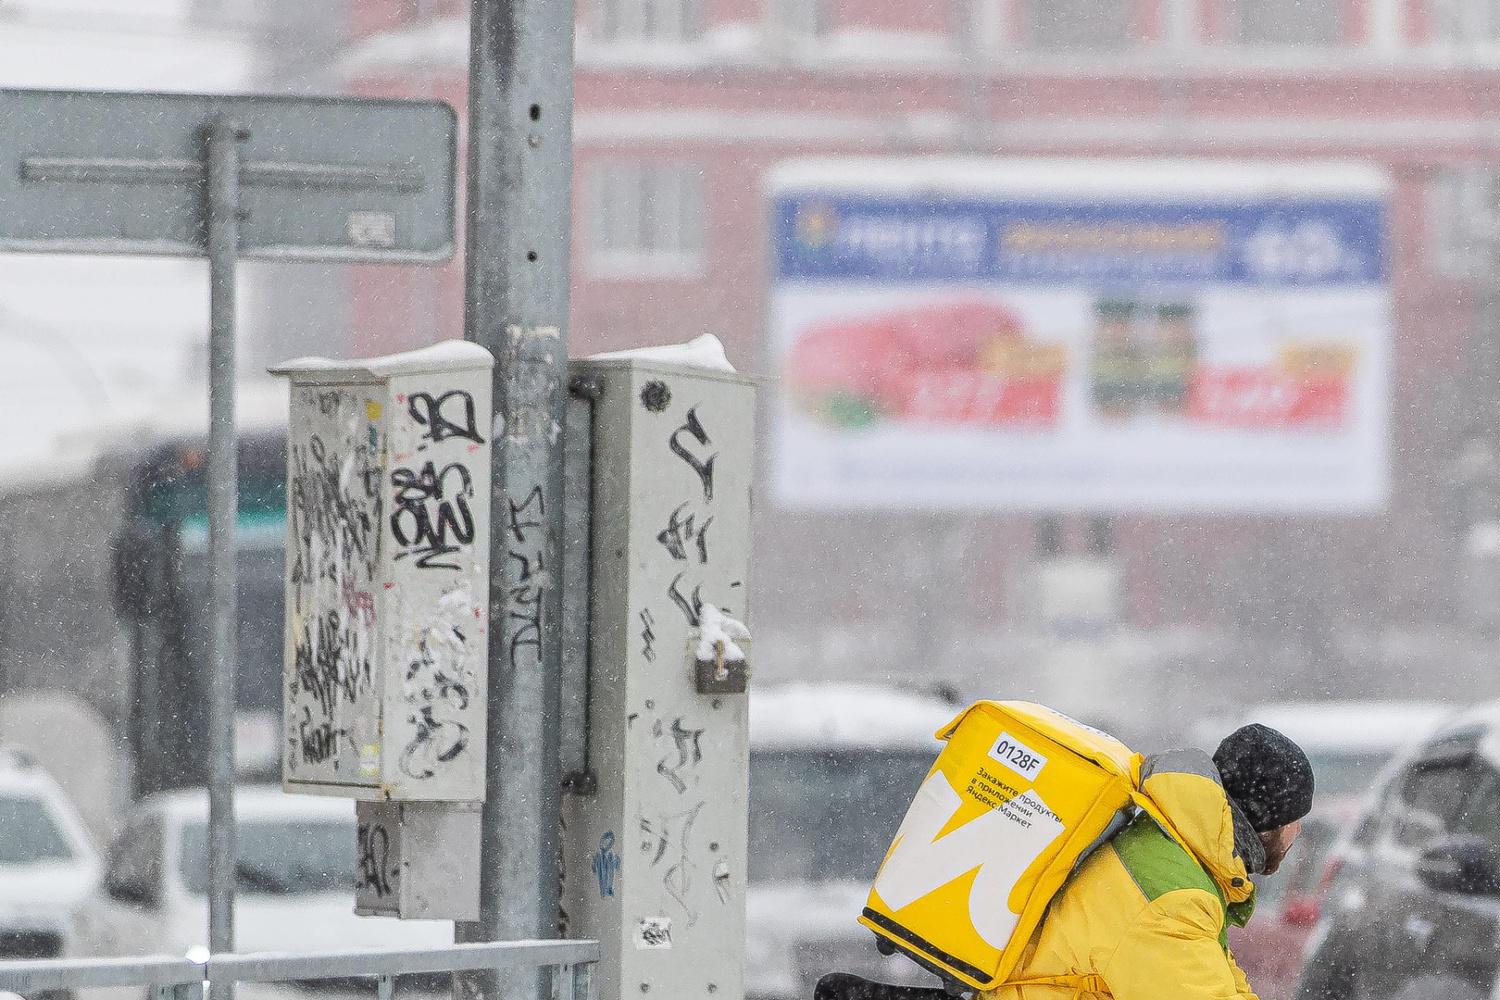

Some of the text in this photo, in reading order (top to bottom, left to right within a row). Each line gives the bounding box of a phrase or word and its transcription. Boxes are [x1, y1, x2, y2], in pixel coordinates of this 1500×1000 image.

[996, 740, 1040, 772] 0128F
[976, 767, 1063, 823] Закажите продукты
[977, 781, 1033, 818] приложении
